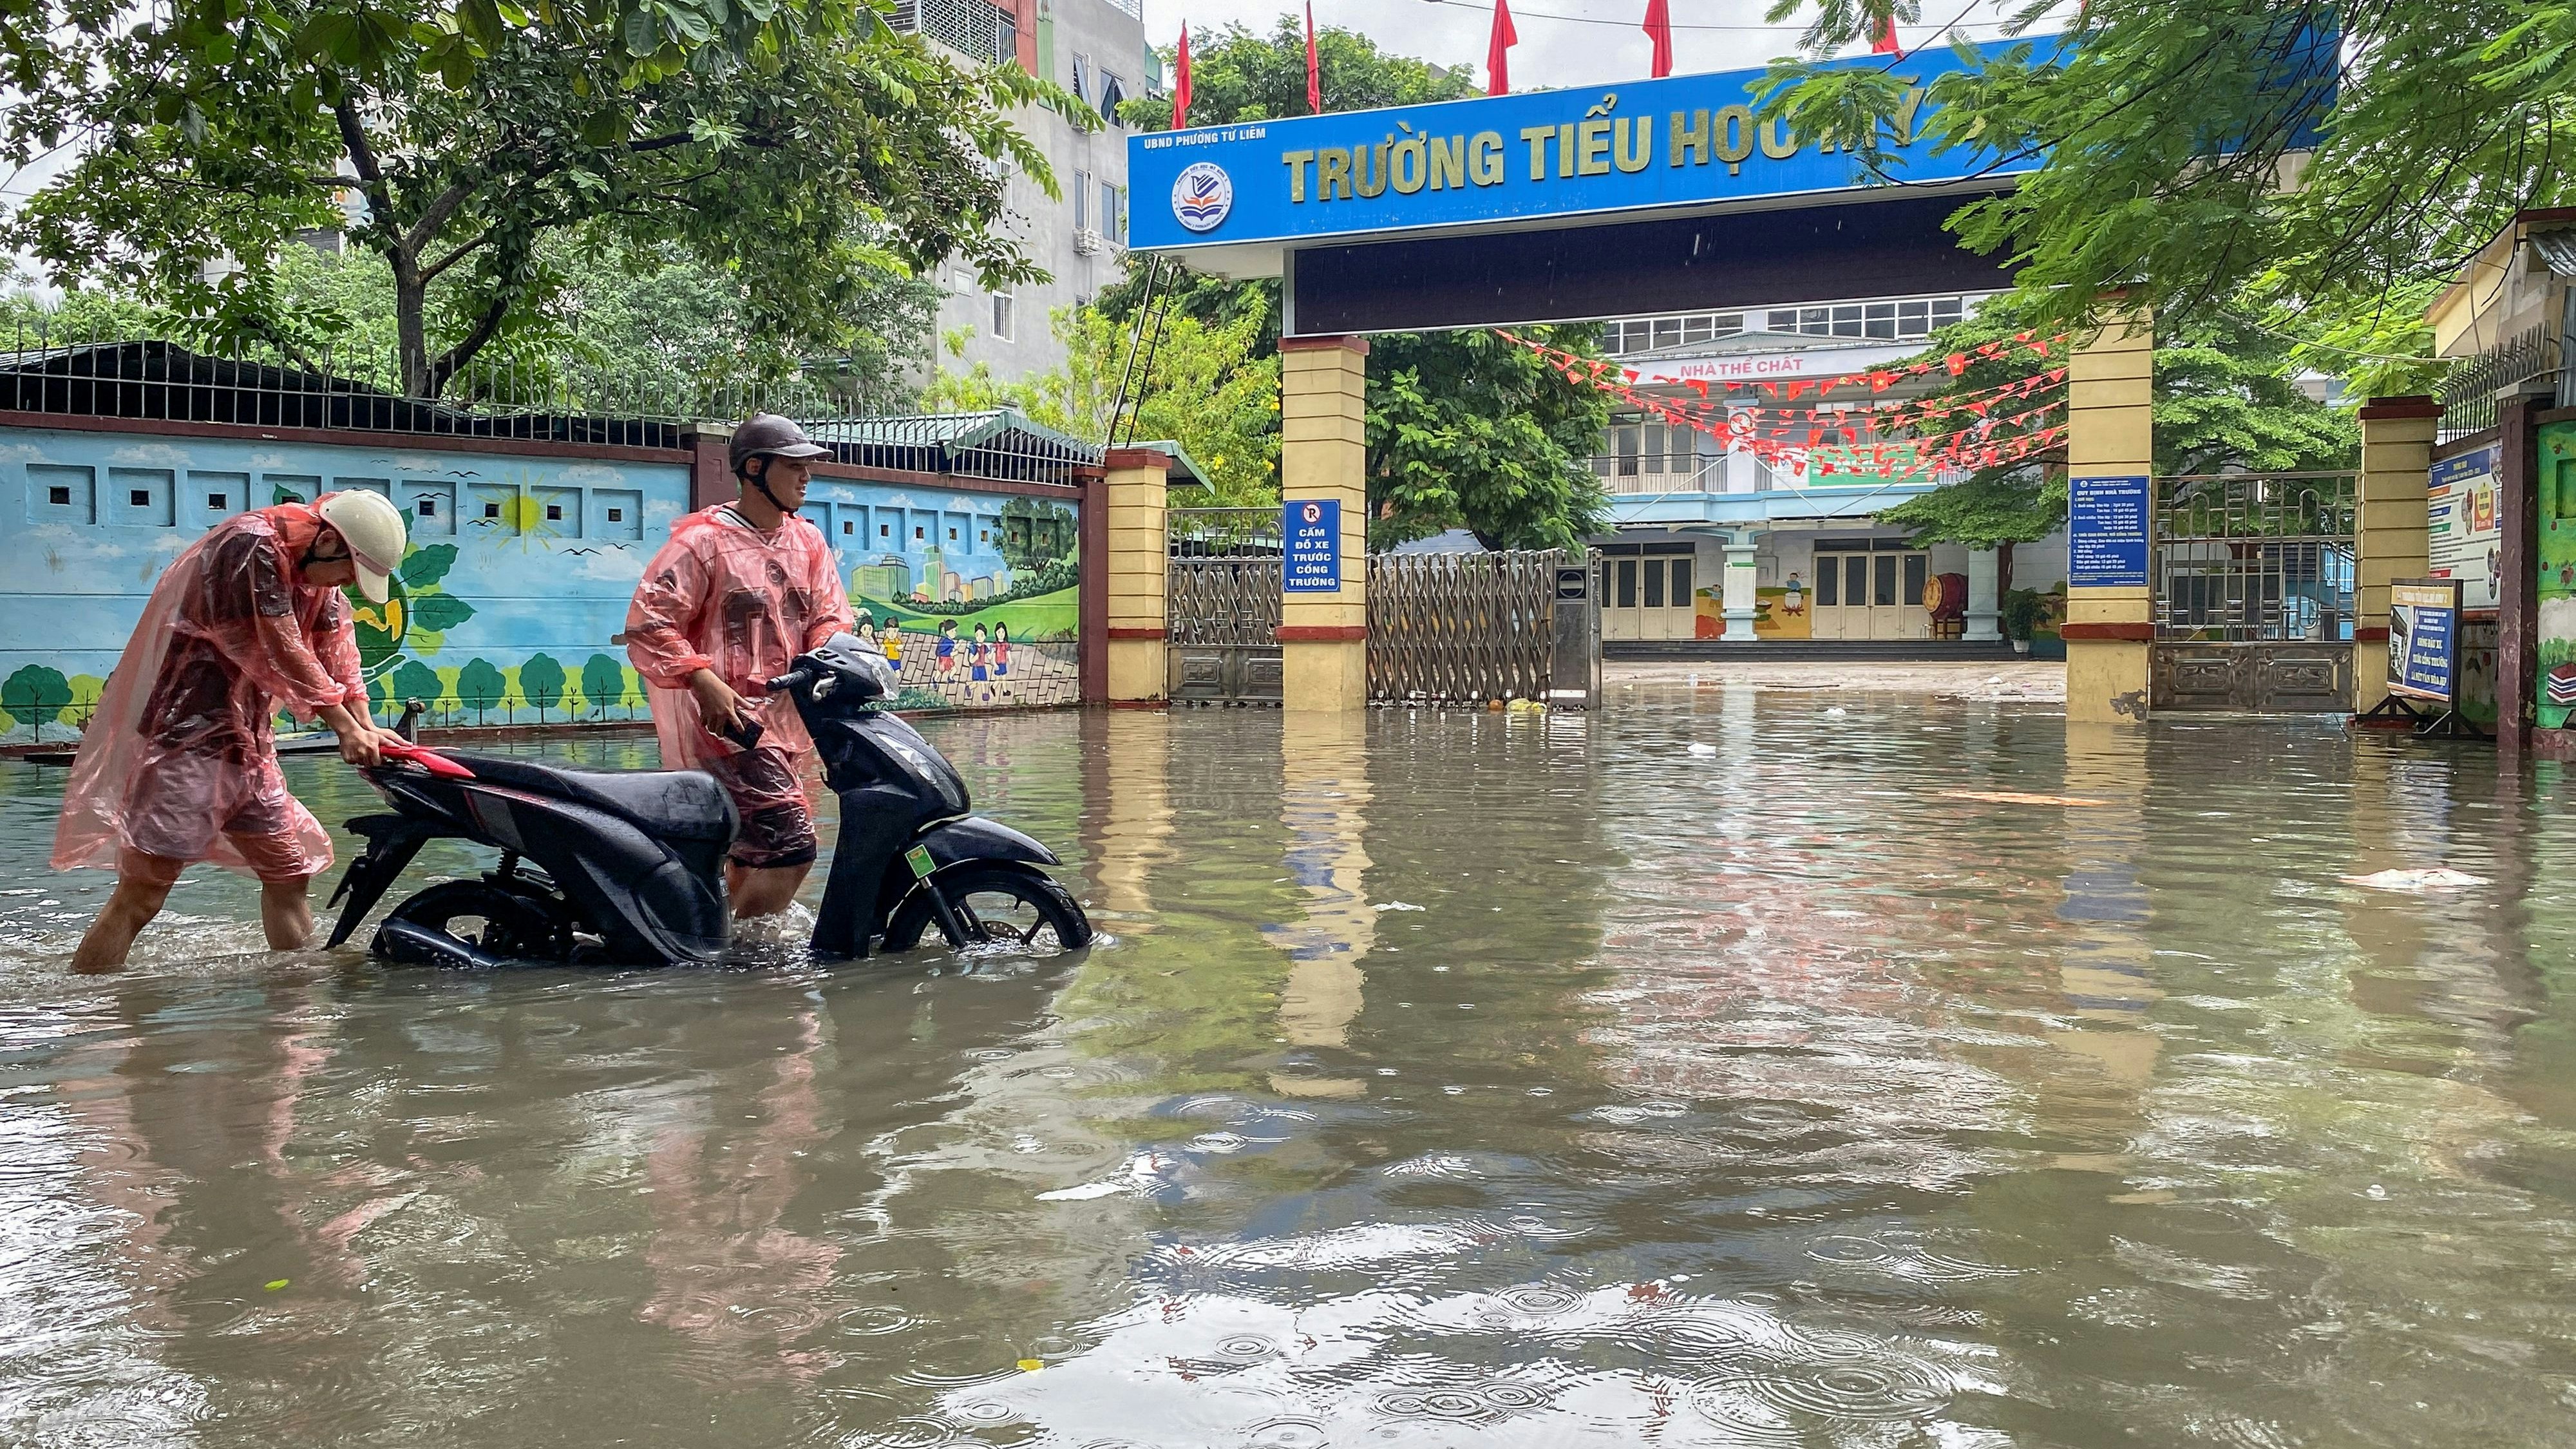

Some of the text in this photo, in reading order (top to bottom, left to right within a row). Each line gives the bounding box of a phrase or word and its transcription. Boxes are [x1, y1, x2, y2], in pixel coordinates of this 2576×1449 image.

[1144, 126, 1266, 149] UBND PHƯỜNG TỪ LIÊM
[1282, 120, 1504, 203] TRƯỜNG
[1520, 93, 1653, 180] TIỂU
[1680, 355, 1804, 376] NHÀ THỂ CHẤT
[1298, 526, 1325, 537] CẤM
[1295, 539, 1329, 549] ĐỖ XE
[1293, 552, 1331, 562] TRƯỚC
[1296, 563, 1328, 574] CỔNG
[1289, 576, 1335, 586] TRƯỜNG
